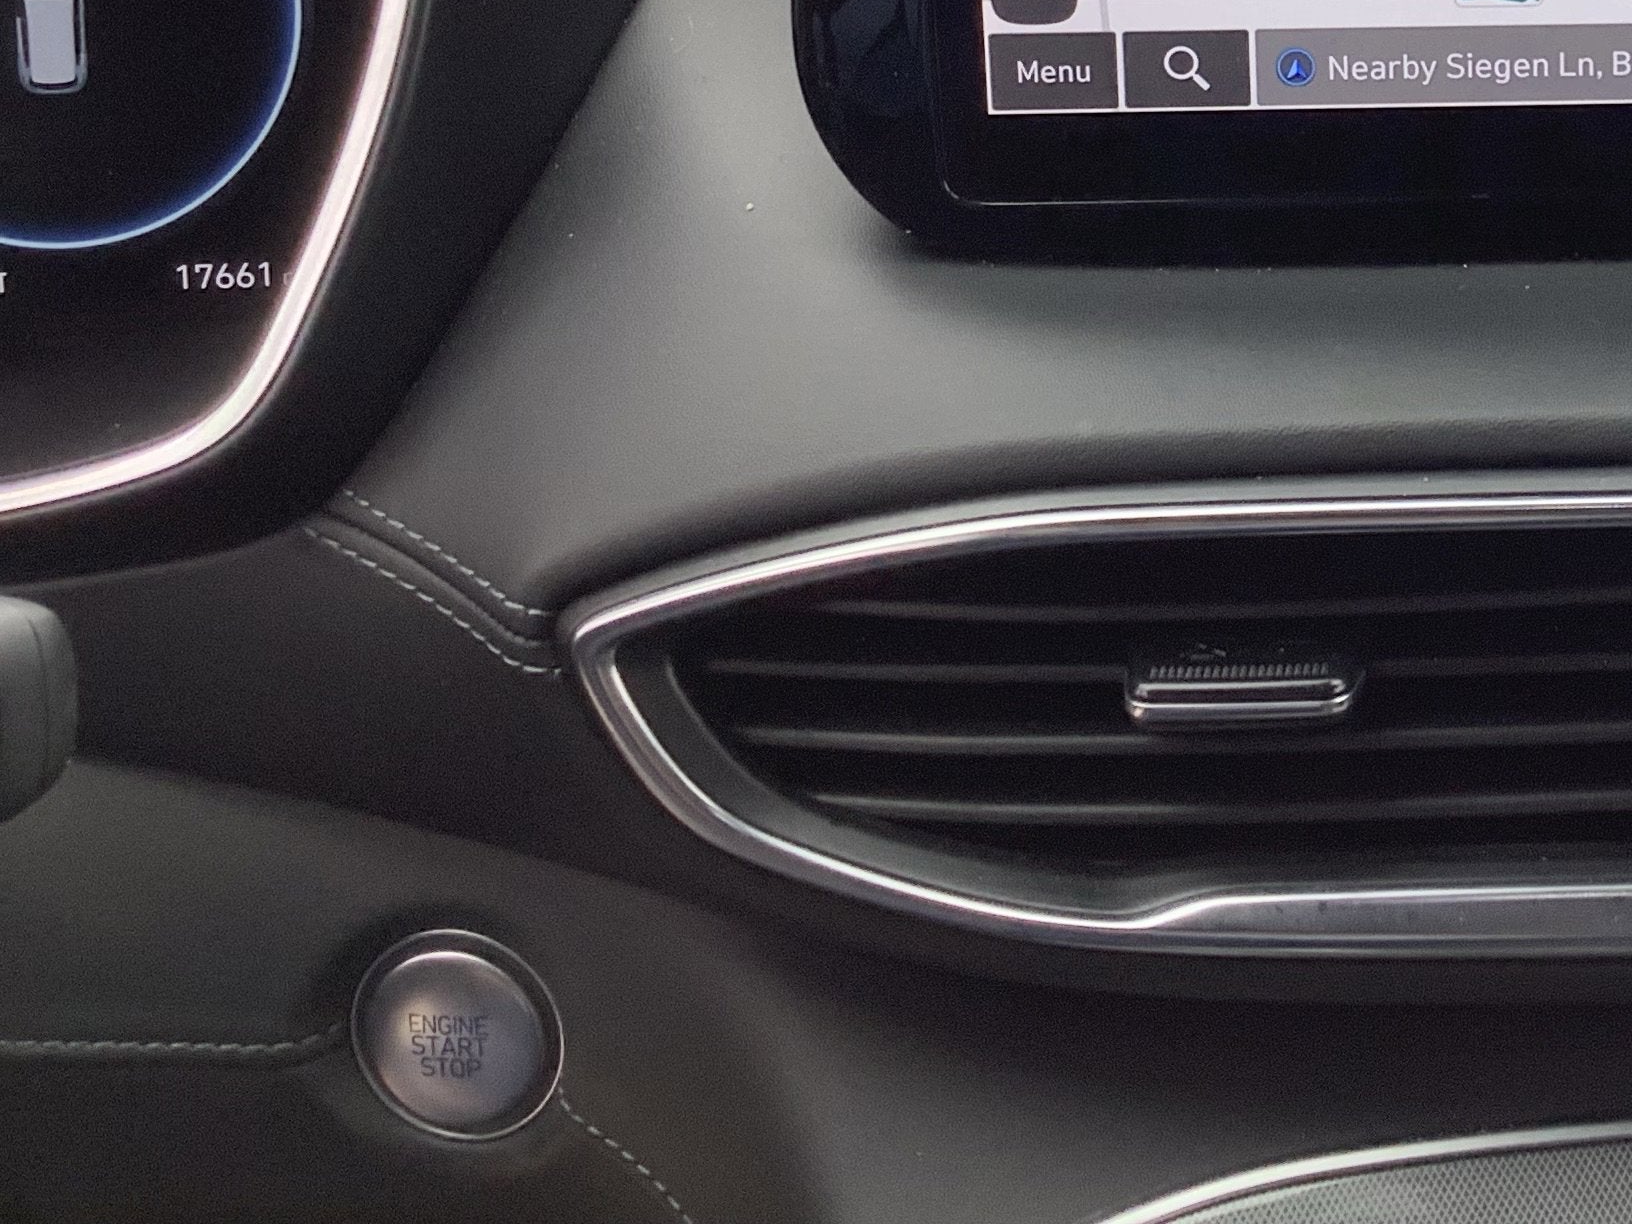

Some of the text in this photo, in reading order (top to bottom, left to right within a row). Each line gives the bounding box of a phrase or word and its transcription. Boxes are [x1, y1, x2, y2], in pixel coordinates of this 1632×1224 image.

[1015, 60, 1092, 84] Menu
[1327, 54, 1437, 85] Nearby
[1446, 52, 1549, 83] Siegen
[1558, 52, 1604, 80] Ln,
[175, 261, 272, 290] 17661
[408, 1013, 489, 1037] ENGINE
[411, 1035, 488, 1058] START
[420, 1057, 482, 1078] STOP
